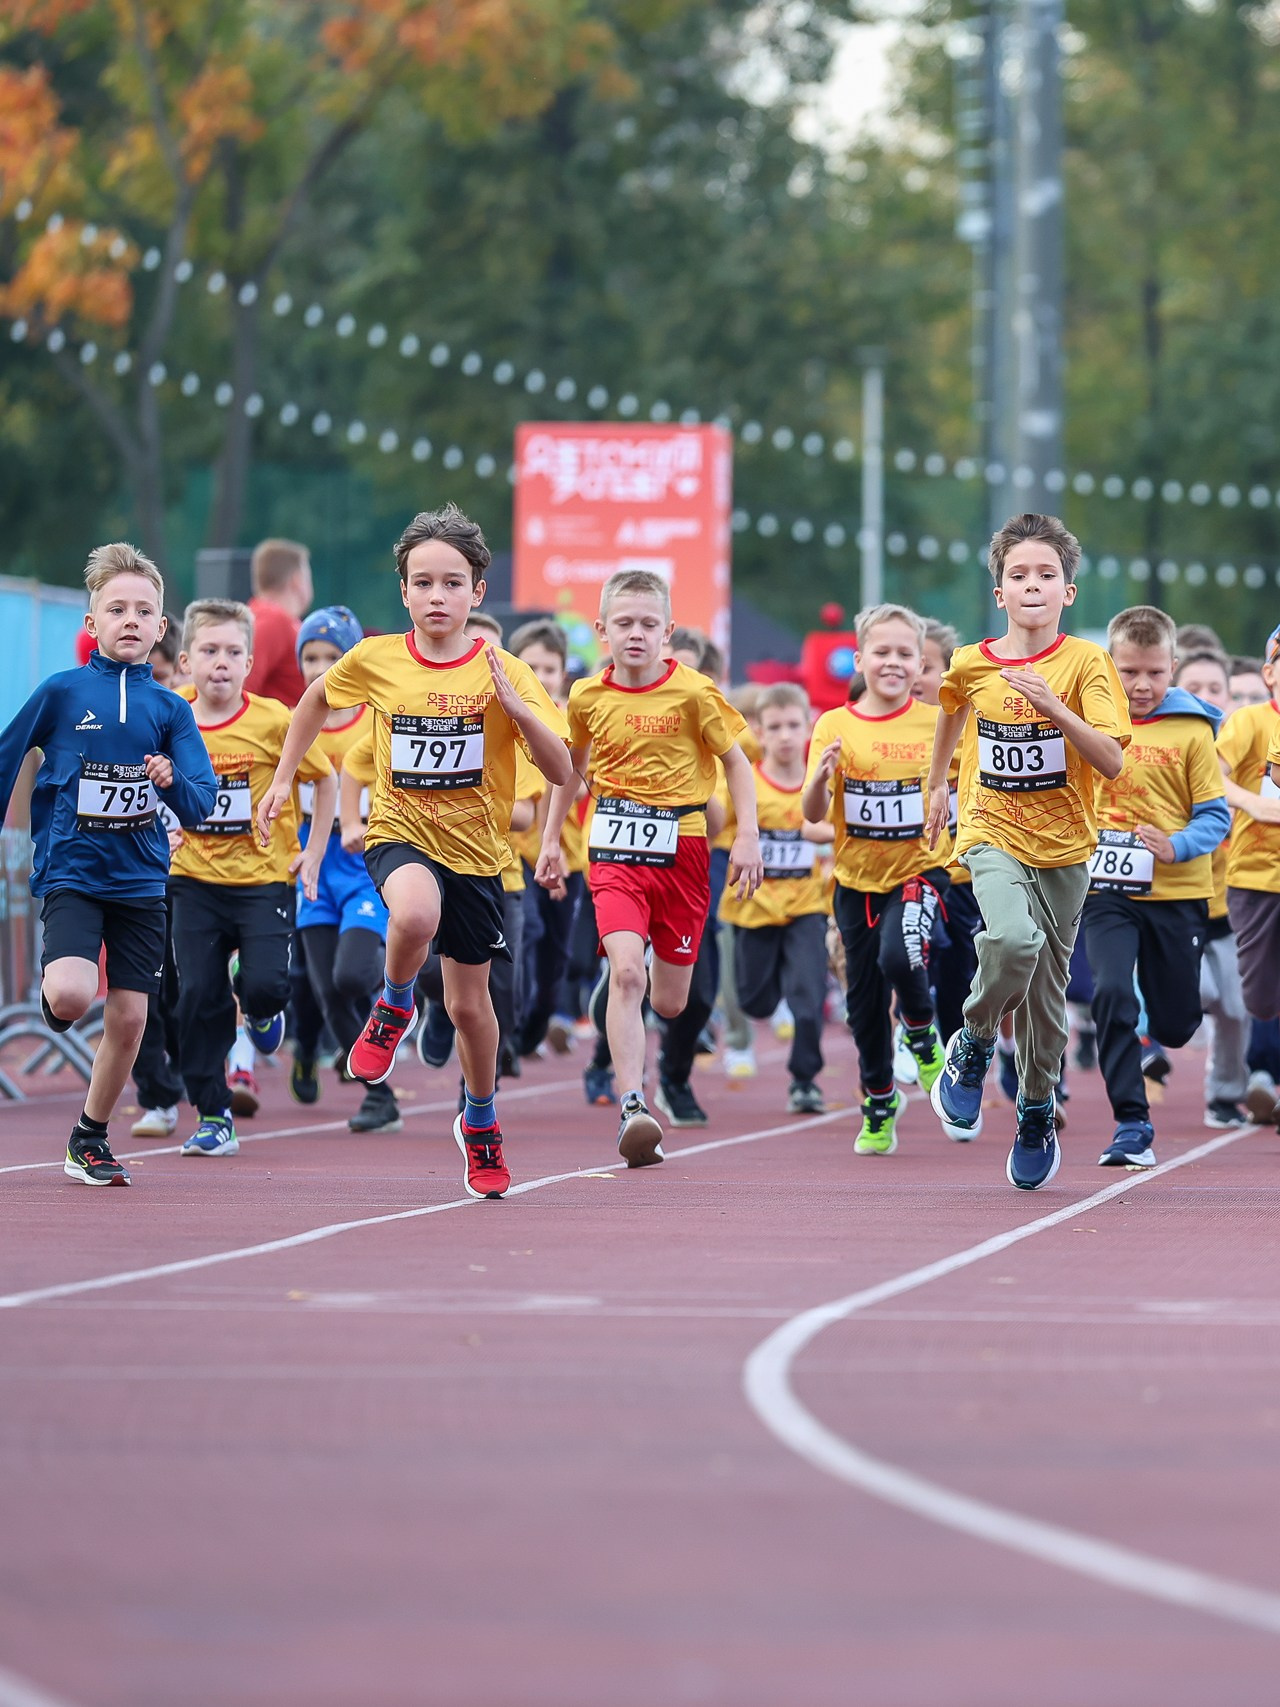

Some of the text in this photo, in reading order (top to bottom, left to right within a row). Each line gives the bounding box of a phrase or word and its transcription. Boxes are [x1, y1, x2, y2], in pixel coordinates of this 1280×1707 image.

[395, 716, 417, 725] 2026
[85, 762, 110, 772] 2026
[410, 740, 467, 769] 797
[992, 744, 1044, 773] 803
[100, 784, 150, 814] 795
[859, 799, 903, 823] 611
[608, 819, 658, 848] 719
[1091, 850, 1134, 875] 786
